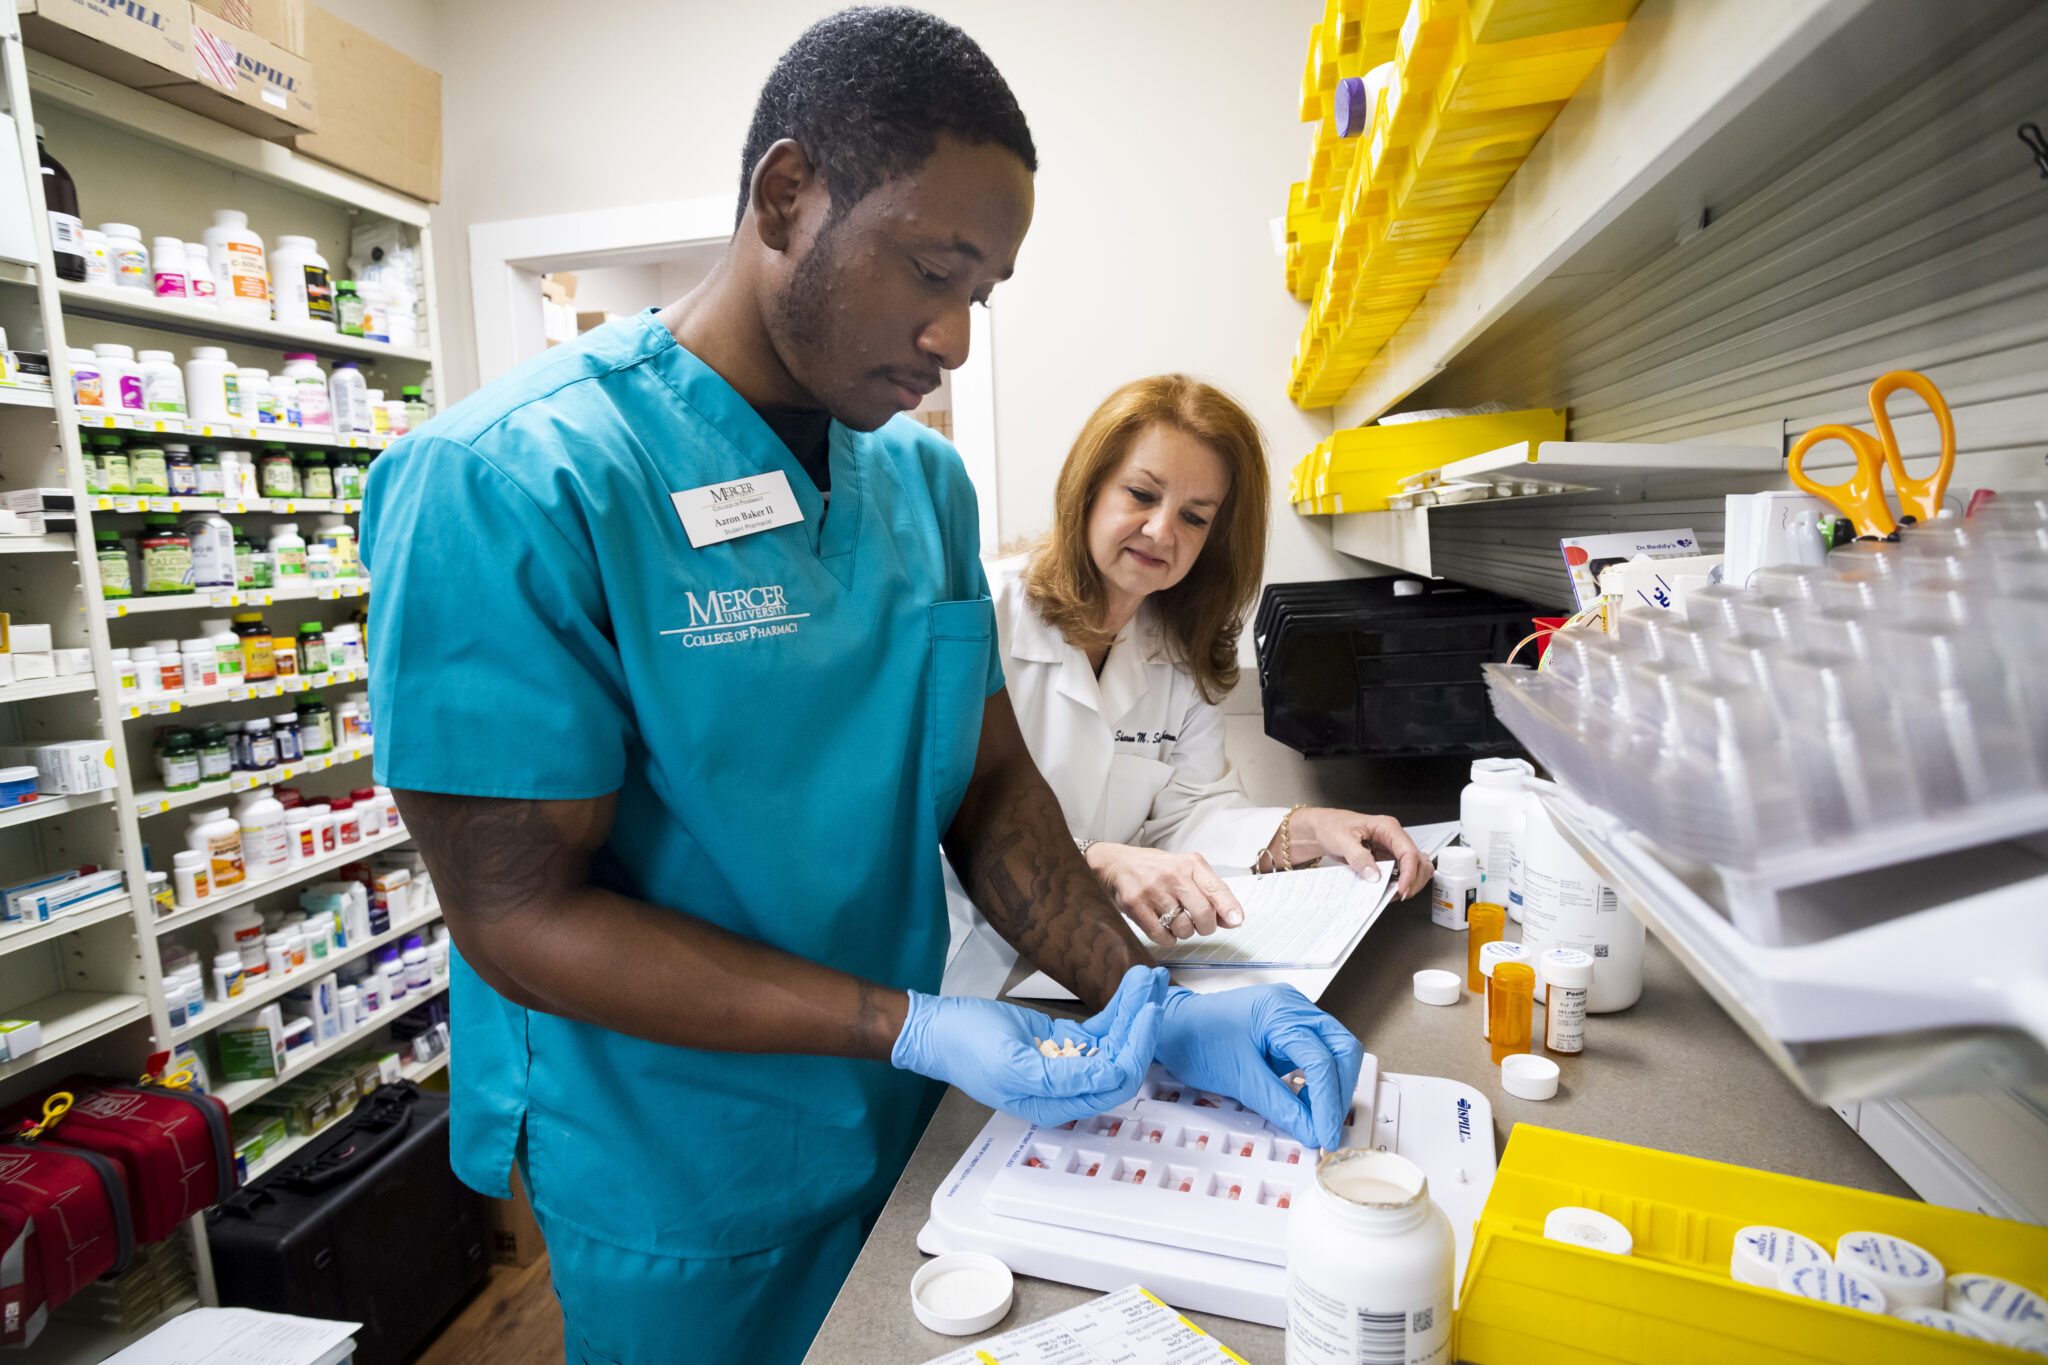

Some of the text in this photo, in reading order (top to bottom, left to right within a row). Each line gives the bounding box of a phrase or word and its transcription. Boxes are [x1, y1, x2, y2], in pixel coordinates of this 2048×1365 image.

[710, 482, 756, 503] MERCER
[715, 505, 774, 527] Aaron Baker II
[724, 525, 744, 535] Student
[684, 585, 789, 627] MERCER
[723, 604, 788, 623] UNIVERSITY
[682, 622, 799, 648] COLLEGE OF PHARMACY
